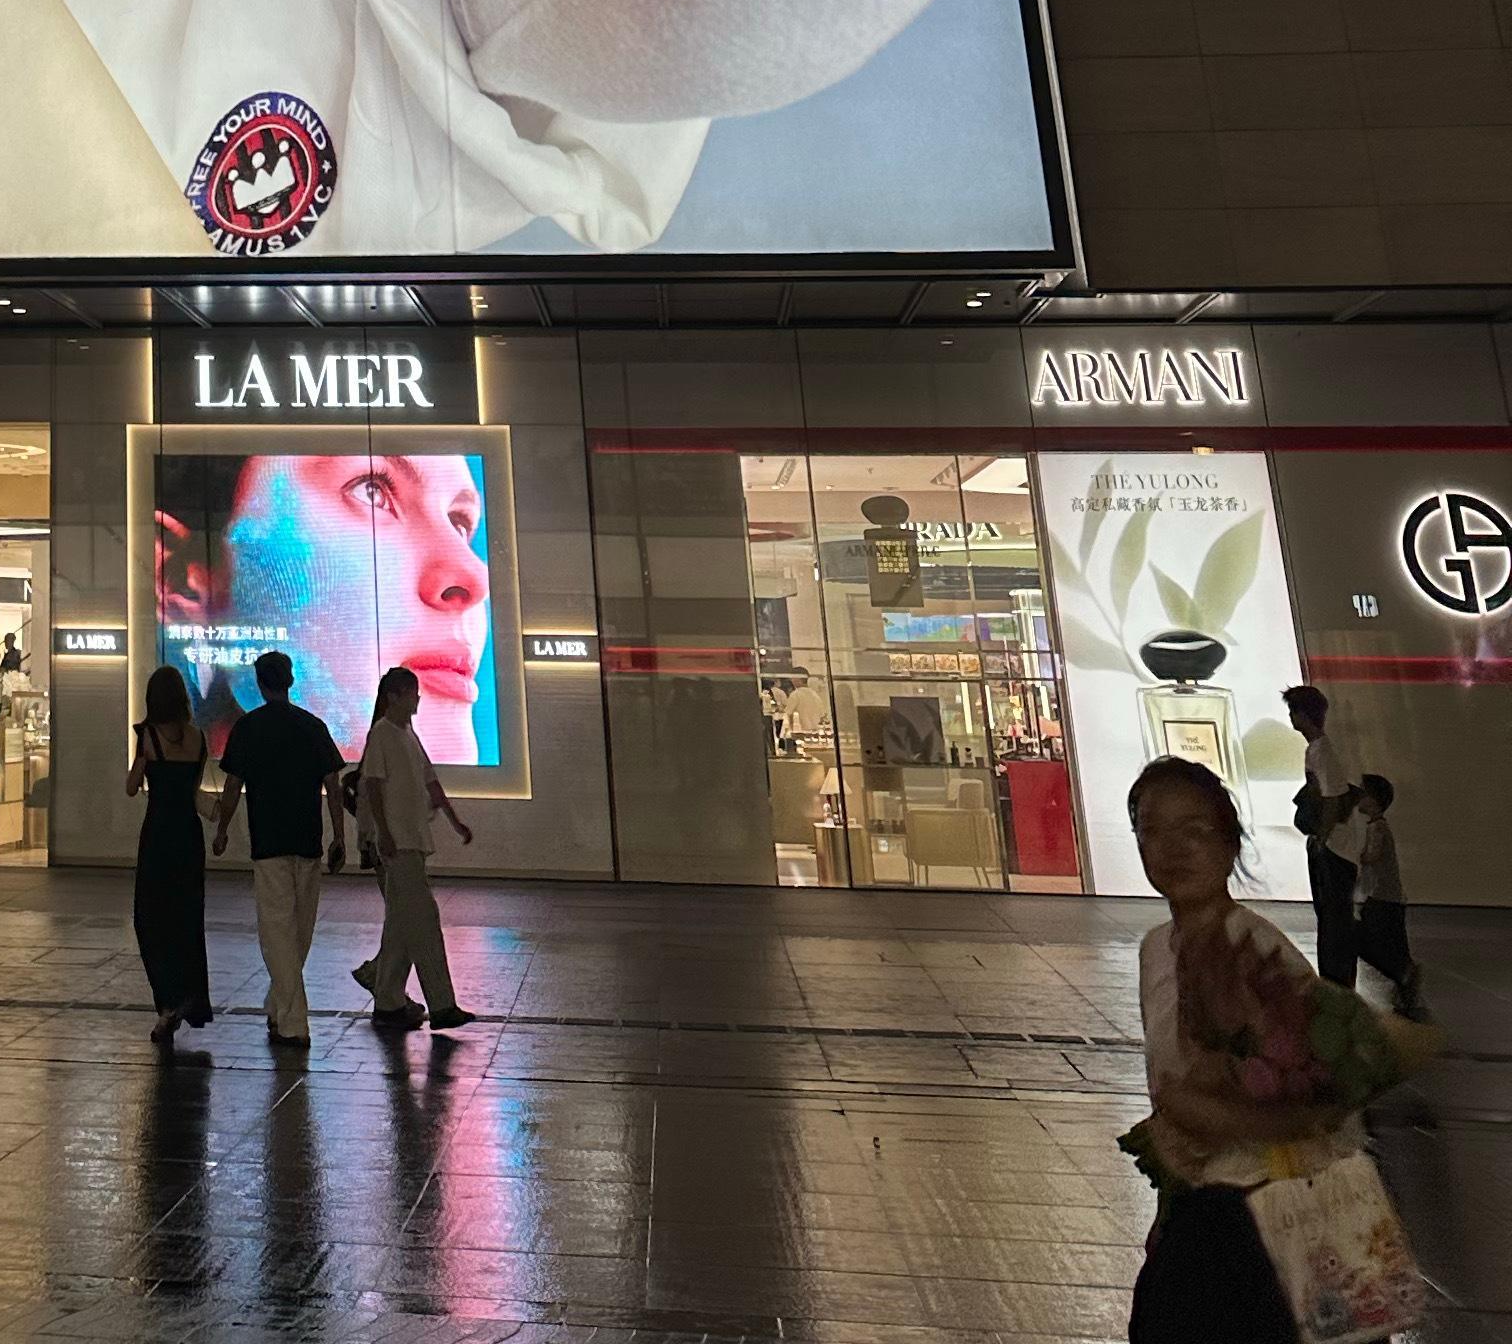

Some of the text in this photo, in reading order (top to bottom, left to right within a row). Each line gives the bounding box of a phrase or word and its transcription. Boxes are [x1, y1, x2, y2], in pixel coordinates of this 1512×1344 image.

[213, 98, 272, 144] YOUR
[277, 97, 328, 151] MIND
[193, 354, 435, 407] LA MER
[1033, 351, 1249, 404] ARMANI
[1138, 473, 1219, 490] YULONG
[899, 522, 1003, 541] RADA
[66, 634, 117, 650] LA MER
[533, 640, 588, 657] LA MER
[183, 646, 270, 666] 专研油皮抗
